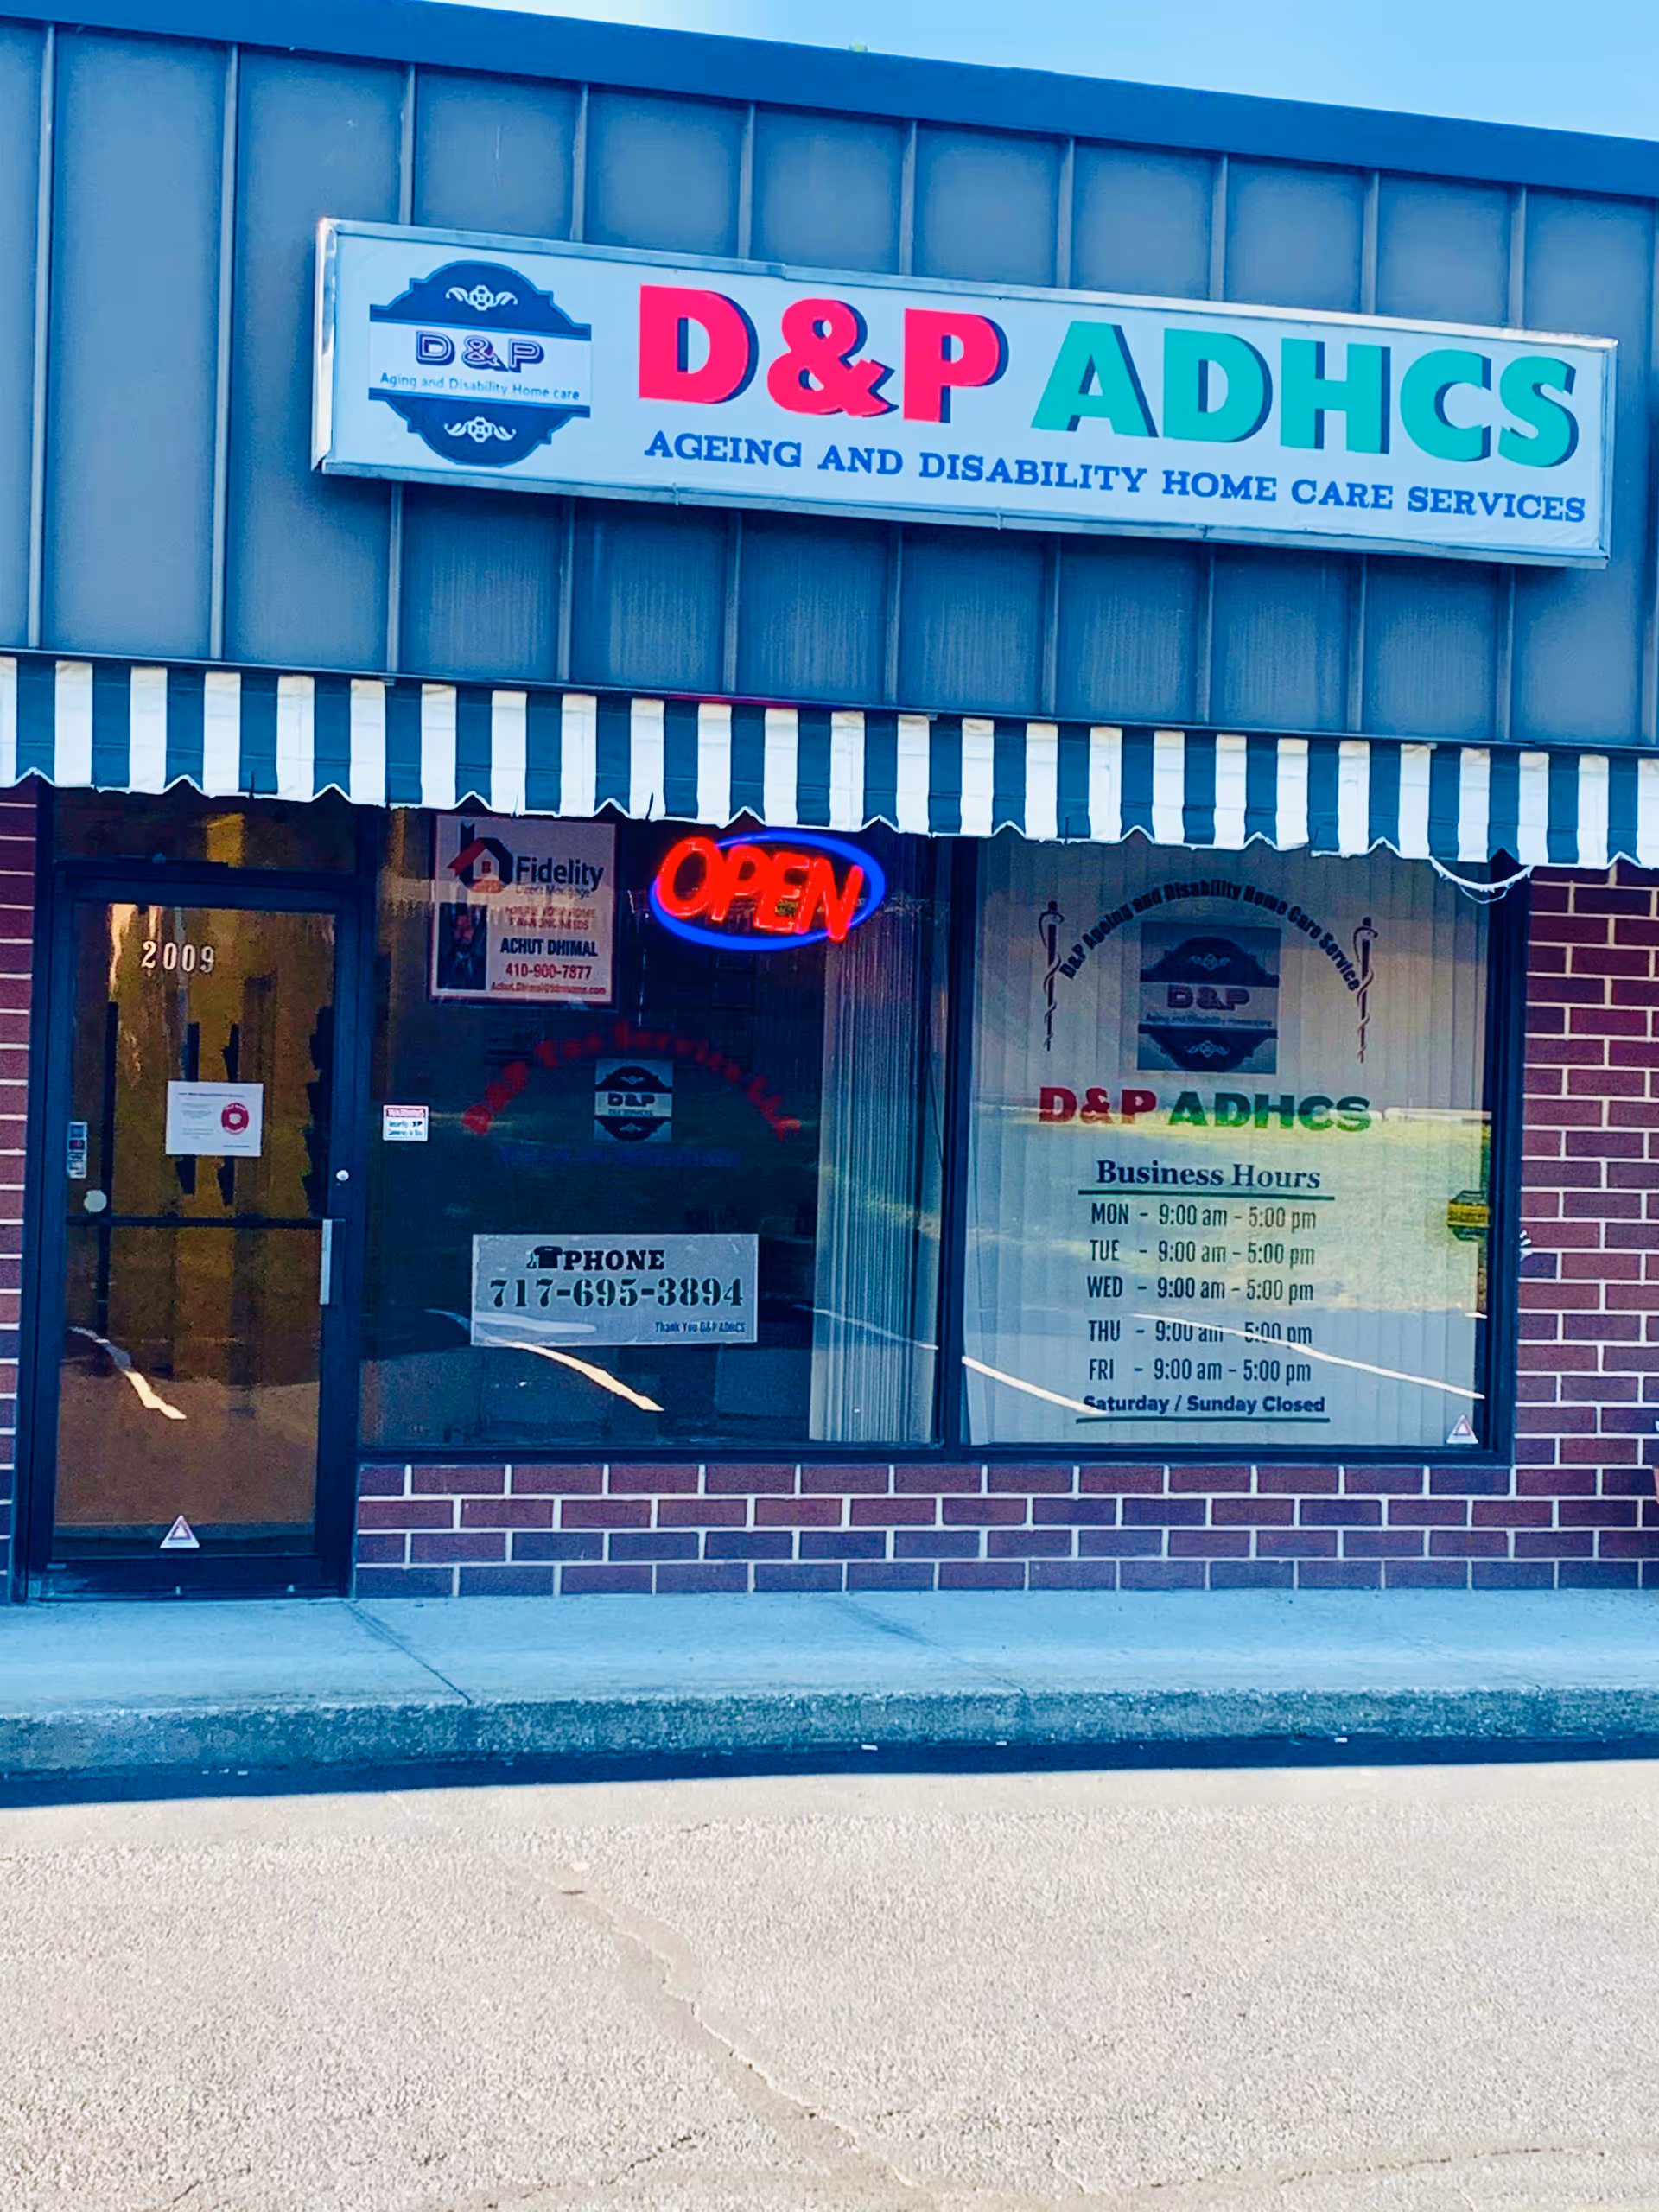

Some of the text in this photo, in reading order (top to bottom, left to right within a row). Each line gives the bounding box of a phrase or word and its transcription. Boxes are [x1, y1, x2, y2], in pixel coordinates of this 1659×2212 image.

[380, 372, 580, 400] Aging and Disability Home care
[639, 284, 1579, 467] D&P ADHCS
[645, 430, 1586, 523] AGEING AND DISABILITY HOME CARE SERVICES
[517, 856, 604, 892] Fidelity
[656, 836, 864, 942] OPEN
[500, 937, 599, 957] ACHUT DHIMAL
[1132, 887, 1164, 912] and
[1163, 879, 1242, 903] Disability
[1243, 885, 1288, 915] Home
[1287, 906, 1323, 939] Care
[1319, 932, 1361, 991] Service
[141, 940, 215, 973] 2009
[1167, 984, 1250, 1010] D&P
[1039, 1086, 1372, 1132] D&P ADHCS
[1096, 1159, 1320, 1189] Business Hours
[1090, 1202, 1129, 1224] MON
[1159, 1204, 1197, 1226] 9:00
[1202, 1209, 1227, 1227] am
[1249, 1206, 1285, 1228] 5:00
[1291, 1212, 1317, 1234] pm
[563, 1249, 664, 1271] PHONE
[1090, 1239, 1120, 1262] TUE
[1158, 1240, 1196, 1262] 9:00
[1201, 1245, 1226, 1263] am
[1247, 1243, 1284, 1264] 5:00
[1289, 1247, 1315, 1270] pm
[490, 1277, 743, 1308] 717-695-3894
[1087, 1275, 1123, 1298] WED
[1157, 1276, 1195, 1299] 9:00
[1199, 1281, 1225, 1299] am
[1246, 1279, 1283, 1300] 5:00
[1288, 1285, 1313, 1306] pm
[655, 1321, 680, 1332] Thank
[1088, 1320, 1121, 1342] THU
[1155, 1320, 1193, 1343] 9:00
[1244, 1322, 1281, 1344] 5:00
[1089, 1358, 1114, 1381] FRI
[1154, 1358, 1192, 1381] 9:00
[1197, 1363, 1222, 1381] am
[1243, 1360, 1280, 1382] 5:00
[1286, 1365, 1311, 1386] pm
[1084, 1395, 1169, 1416] Saturday
[1186, 1395, 1260, 1416] Sunday
[1262, 1395, 1325, 1413] Closed
